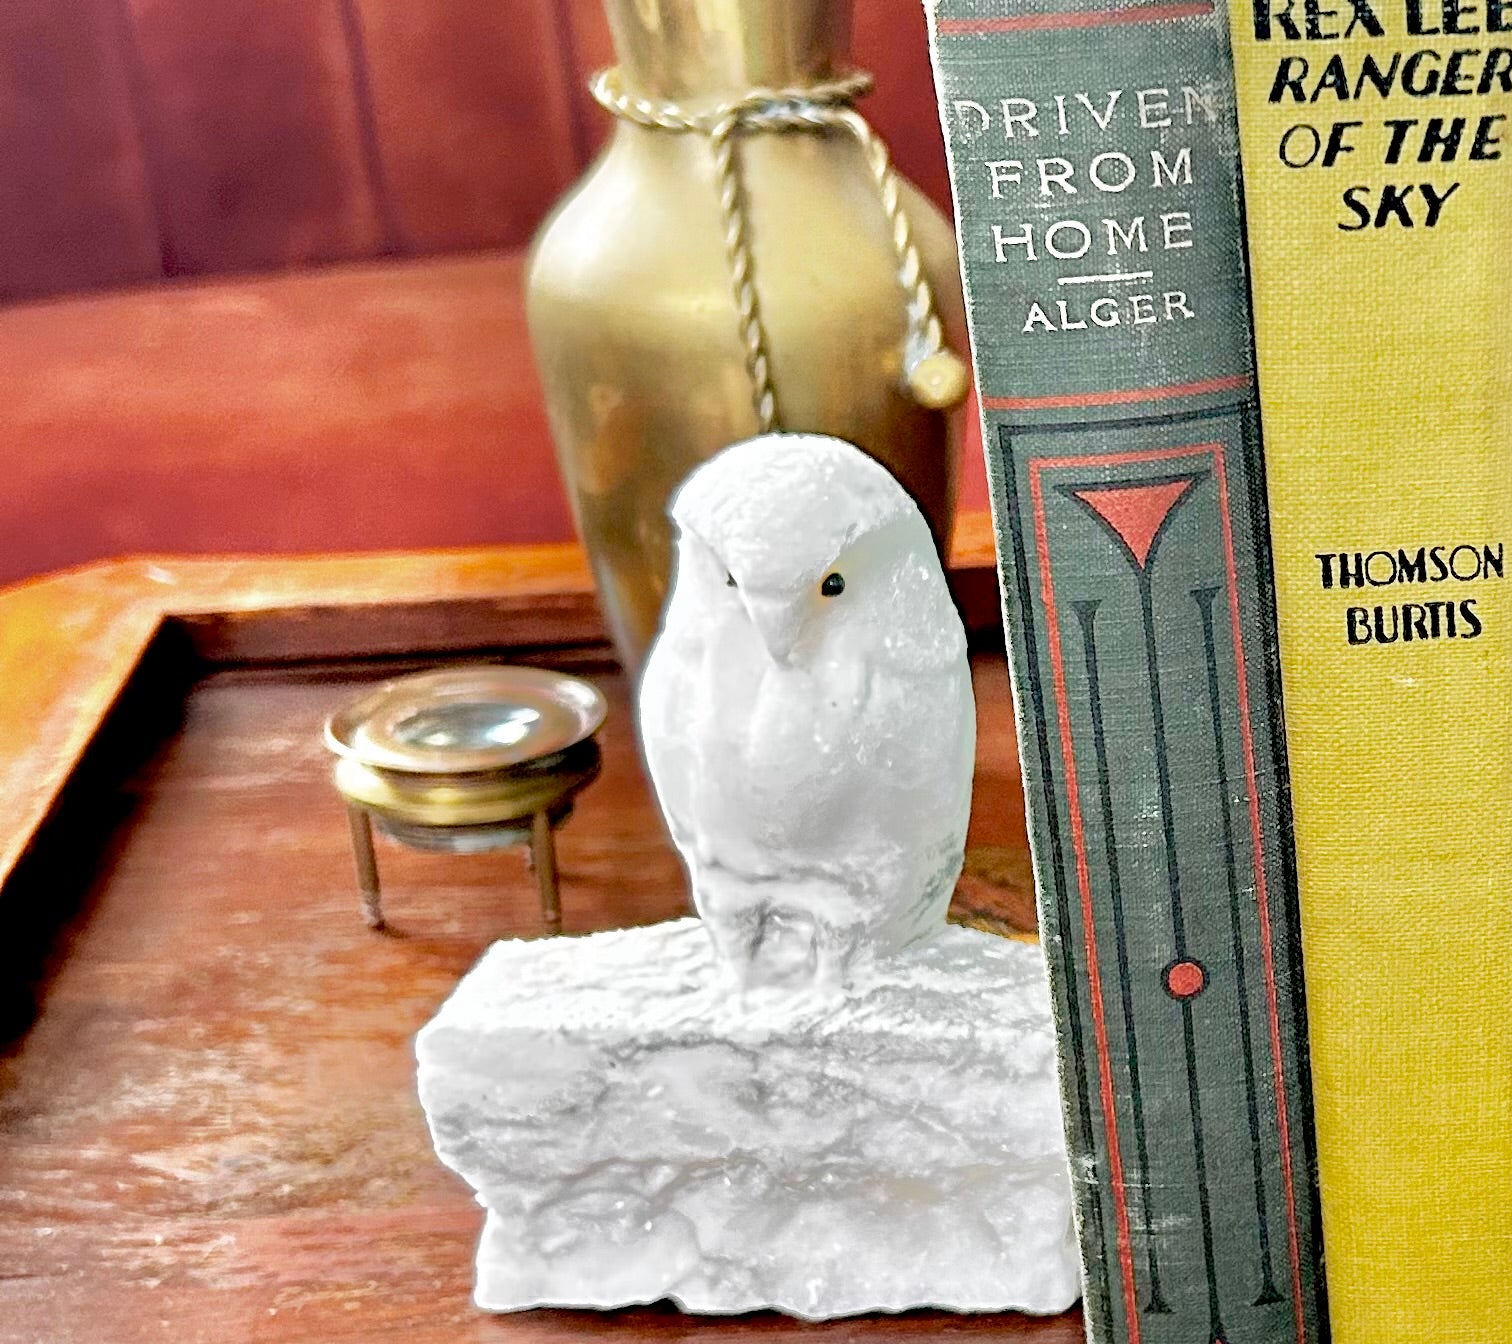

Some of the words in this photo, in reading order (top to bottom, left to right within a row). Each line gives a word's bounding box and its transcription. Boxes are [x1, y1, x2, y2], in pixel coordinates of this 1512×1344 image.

[1279, 122, 1362, 169] OF
[1383, 113, 1508, 164] THE
[983, 148, 1194, 200] FROM
[1337, 181, 1461, 232] SKY
[990, 211, 1194, 264] HOME
[1021, 291, 1196, 334] ALGER
[1314, 542, 1504, 589] THOMSON
[1346, 598, 1482, 645] BURTIS
